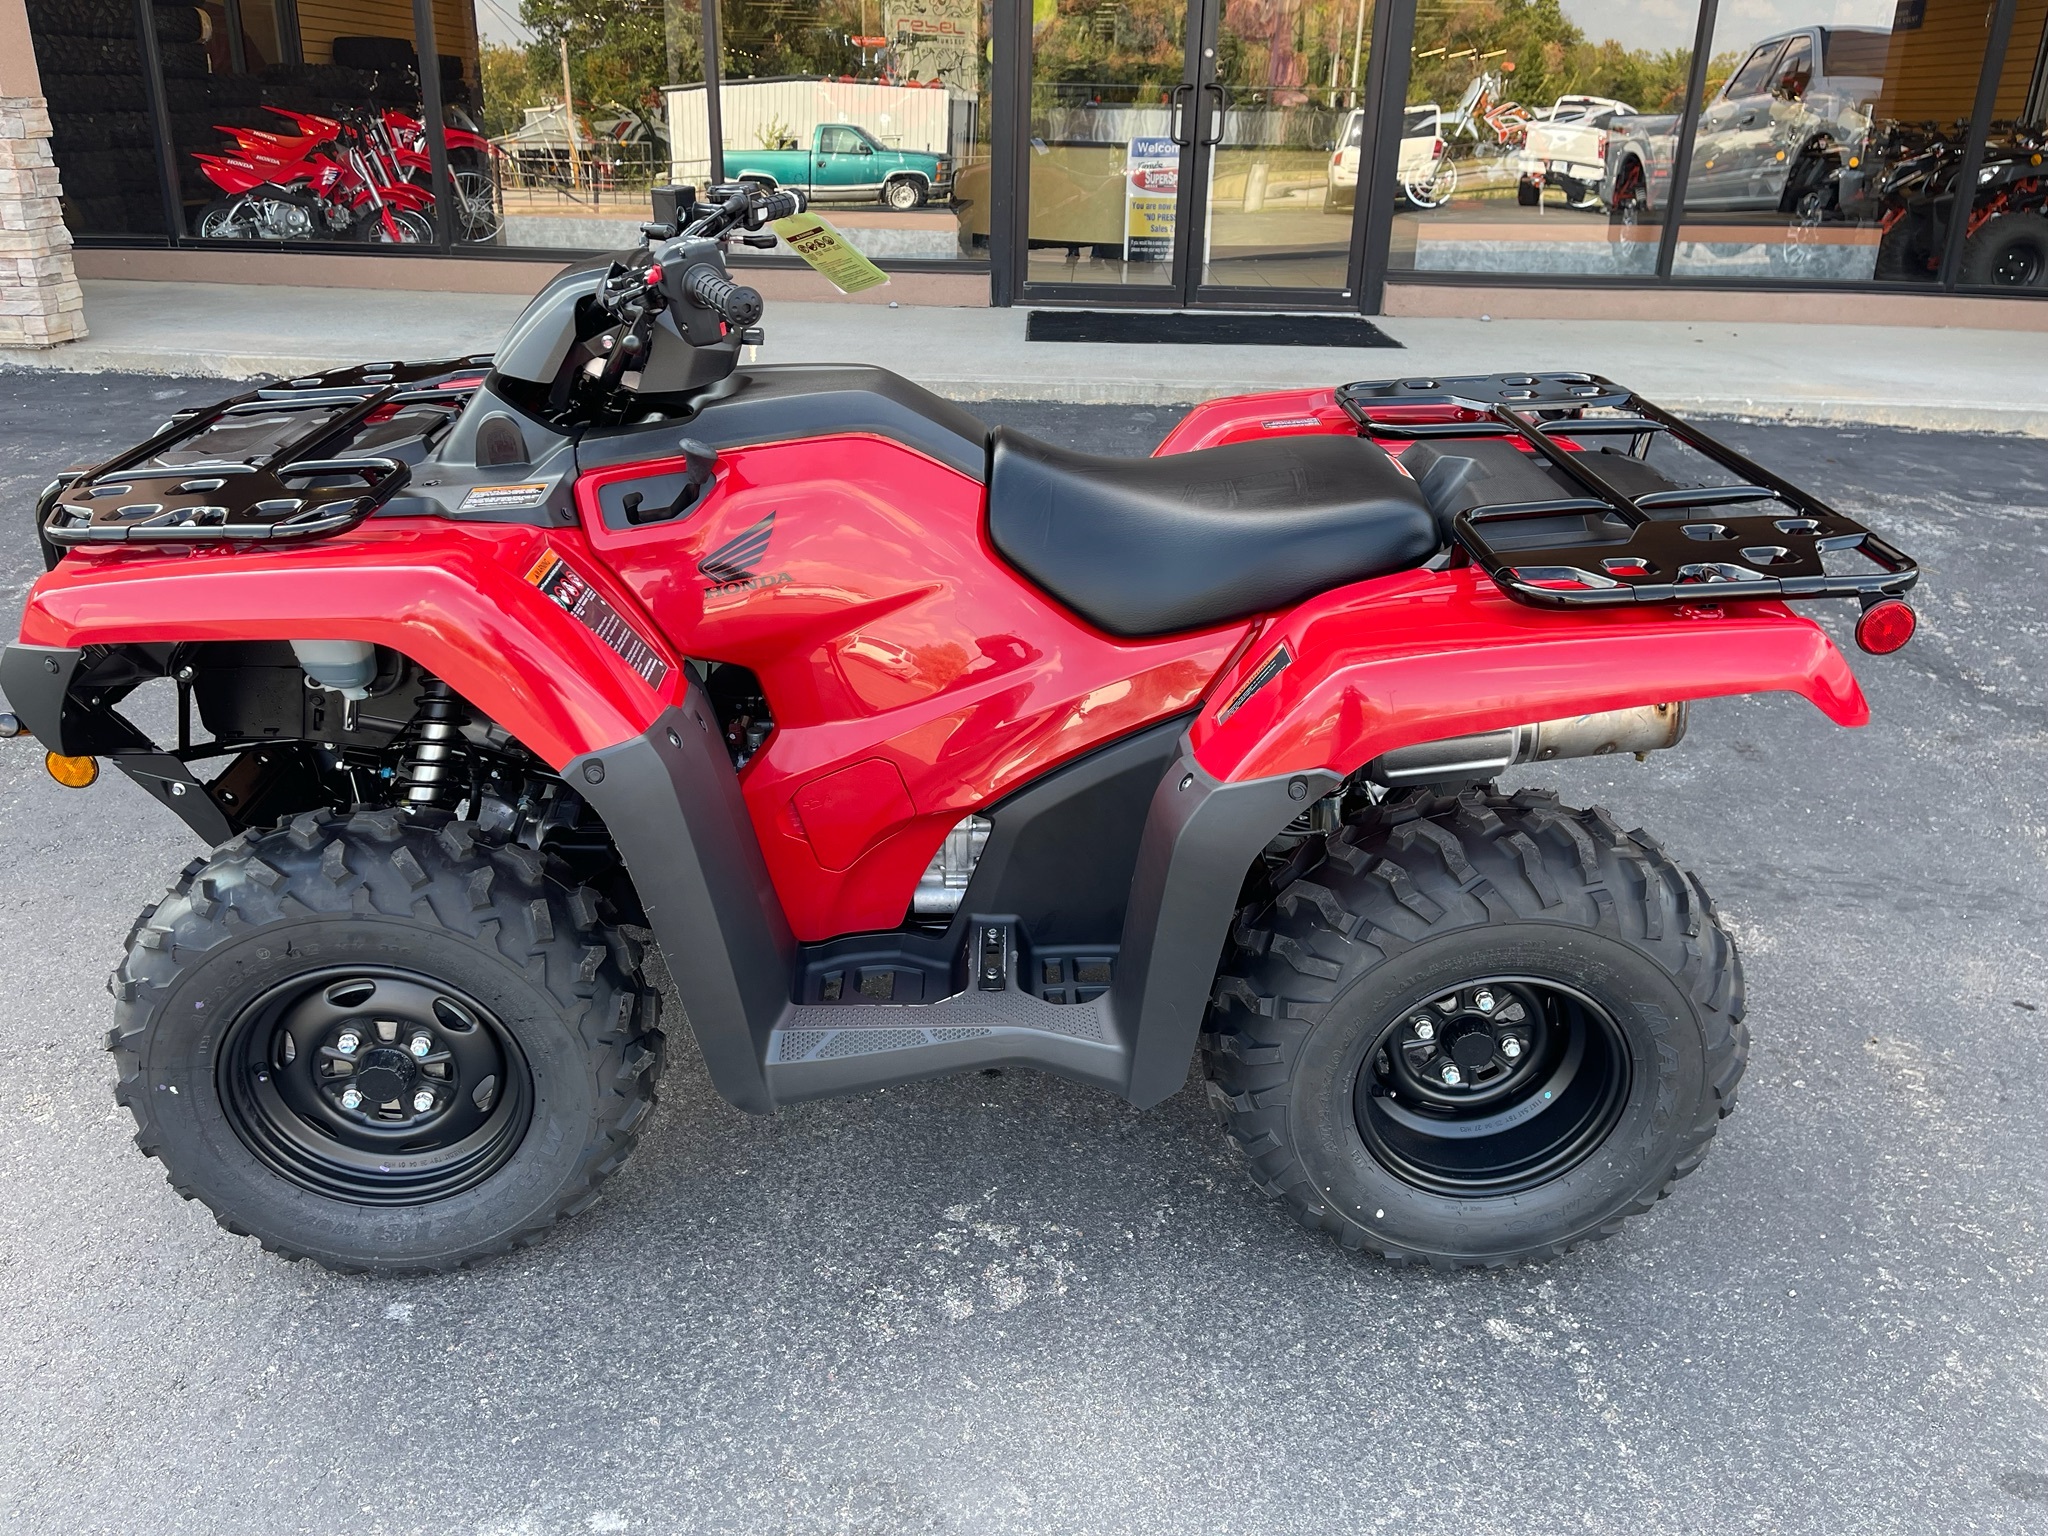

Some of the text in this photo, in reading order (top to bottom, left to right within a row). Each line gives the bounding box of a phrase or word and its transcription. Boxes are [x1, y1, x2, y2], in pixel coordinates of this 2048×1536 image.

[314, 116, 336, 126] HONDA
[253, 130, 277, 142] HONDA
[226, 159, 254, 170] HONDA
[256, 154, 281, 165] HONDA
[1132, 202, 1144, 210] You
[1150, 224, 1168, 233] Sales
[703, 572, 796, 599] HONDA
[1239, 659, 1270, 694] WARNING
[1597, 1002, 1681, 1198] MAXXIS
[373, 1118, 567, 1242] MAXXIS
